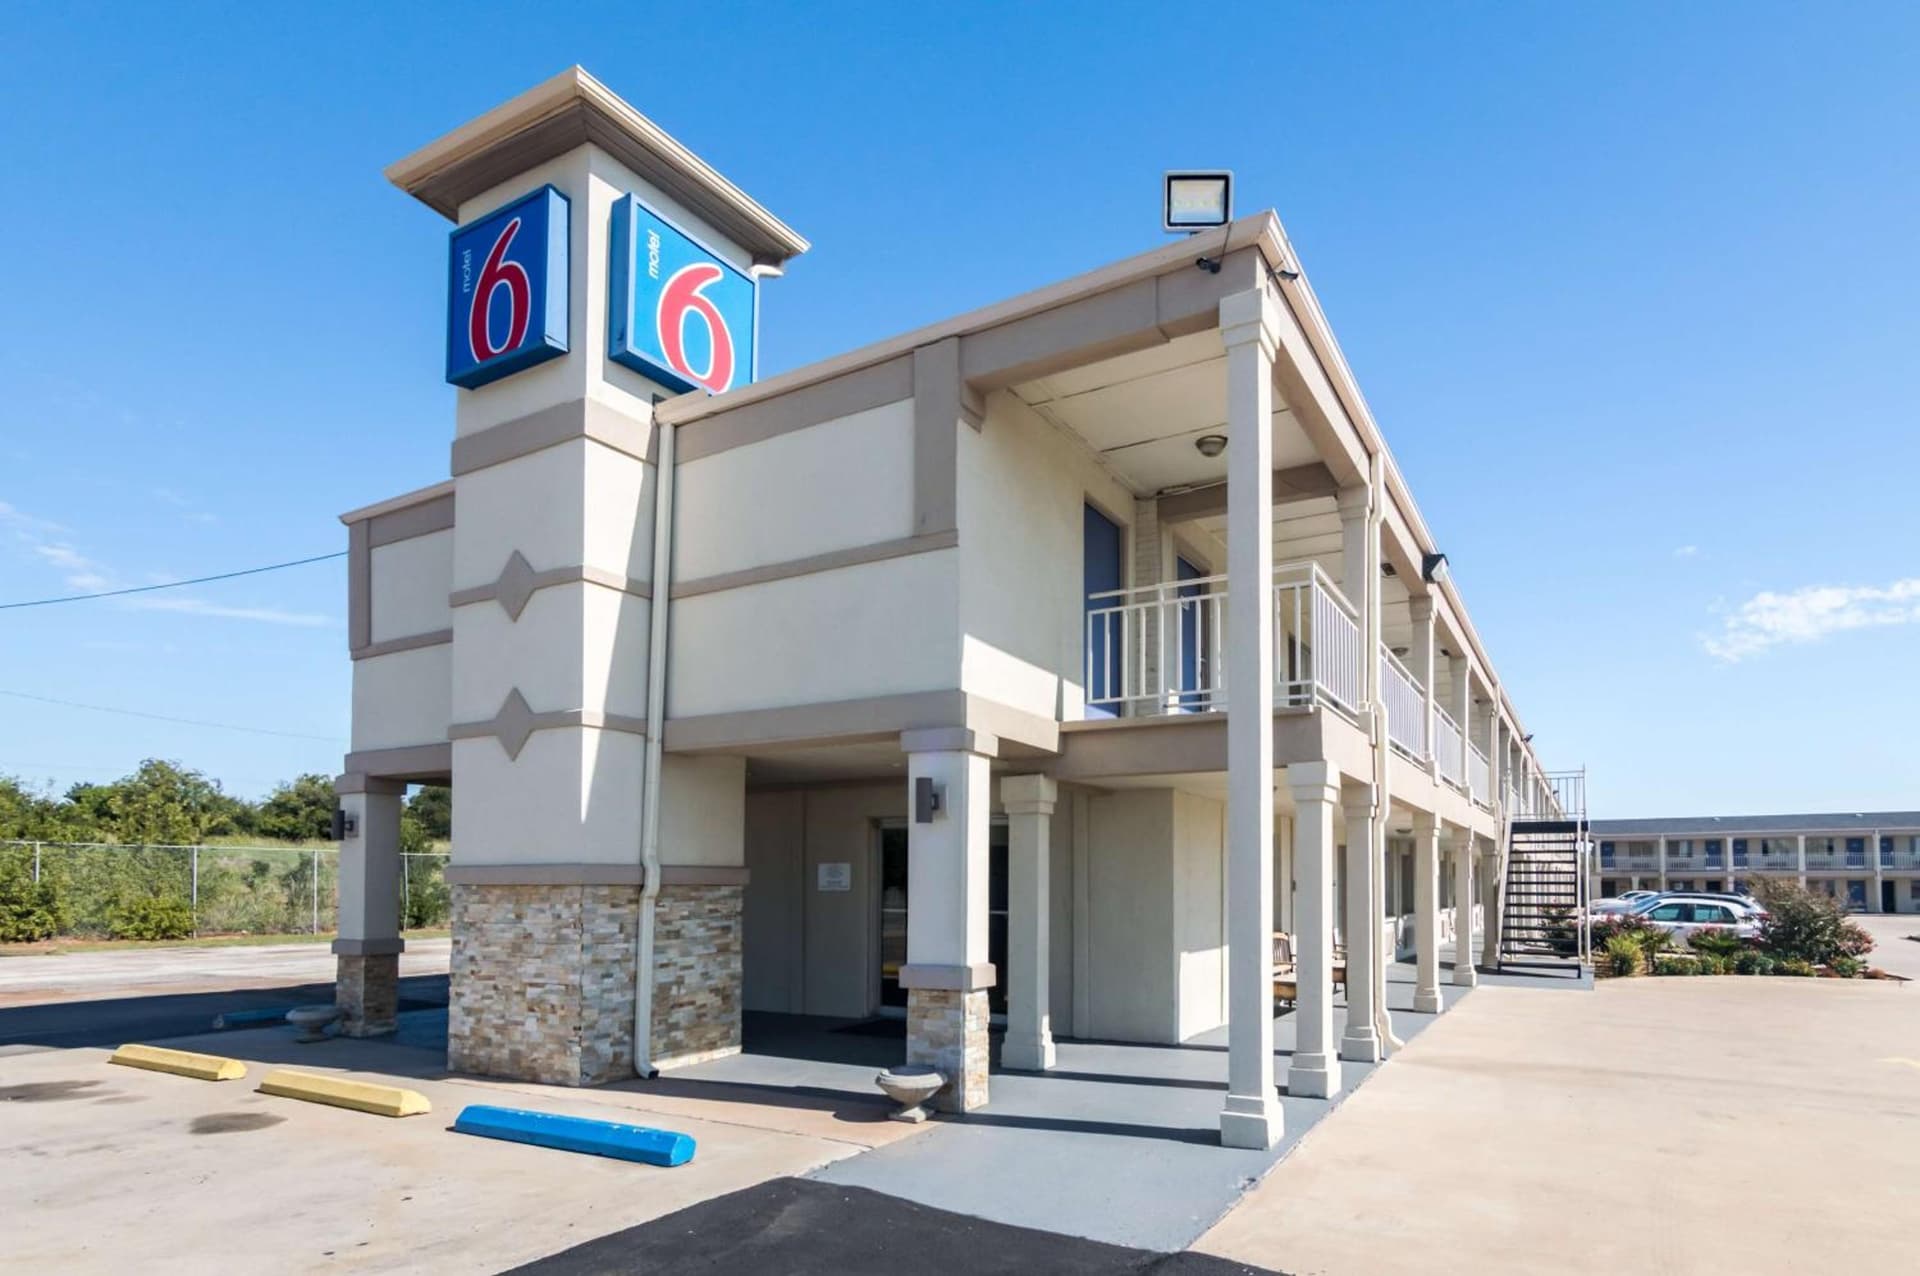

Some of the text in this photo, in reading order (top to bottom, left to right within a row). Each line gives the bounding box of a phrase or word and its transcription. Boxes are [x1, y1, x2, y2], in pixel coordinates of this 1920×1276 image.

[462, 249, 472, 293] motel
[469, 217, 532, 364] 6
[648, 229, 660, 280] motel
[656, 262, 736, 394] 6
